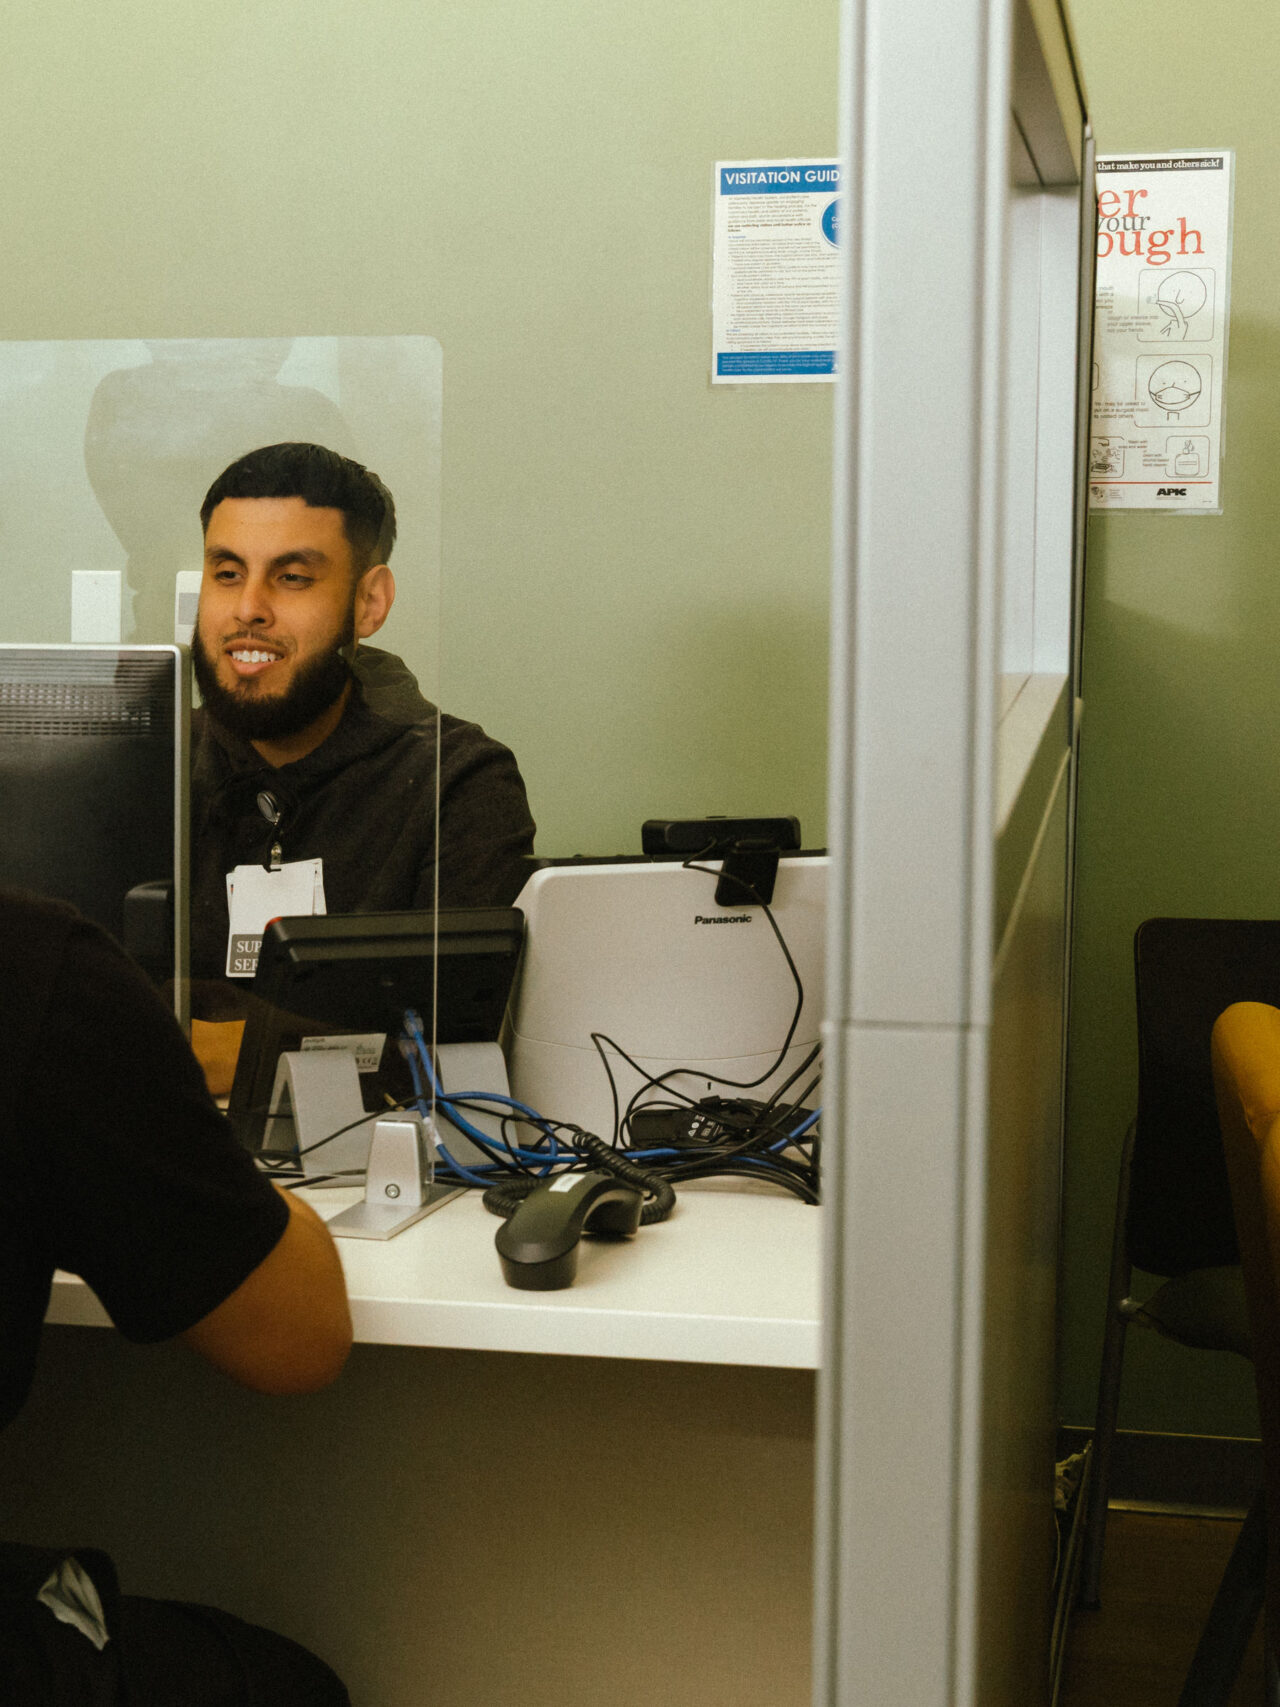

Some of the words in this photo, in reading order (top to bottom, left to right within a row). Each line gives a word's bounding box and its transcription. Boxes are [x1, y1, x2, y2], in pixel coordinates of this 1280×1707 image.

[1097, 162, 1116, 170] that
[1116, 161, 1139, 170] make
[1140, 161, 1156, 171] you
[1156, 160, 1172, 169] and
[1173, 160, 1199, 168] others
[1200, 159, 1220, 168] sick!
[725, 171, 800, 185] VISITATION
[1157, 488, 1187, 496] APIC
[694, 914, 752, 925] Panasonic
[236, 940, 262, 953] SUP
